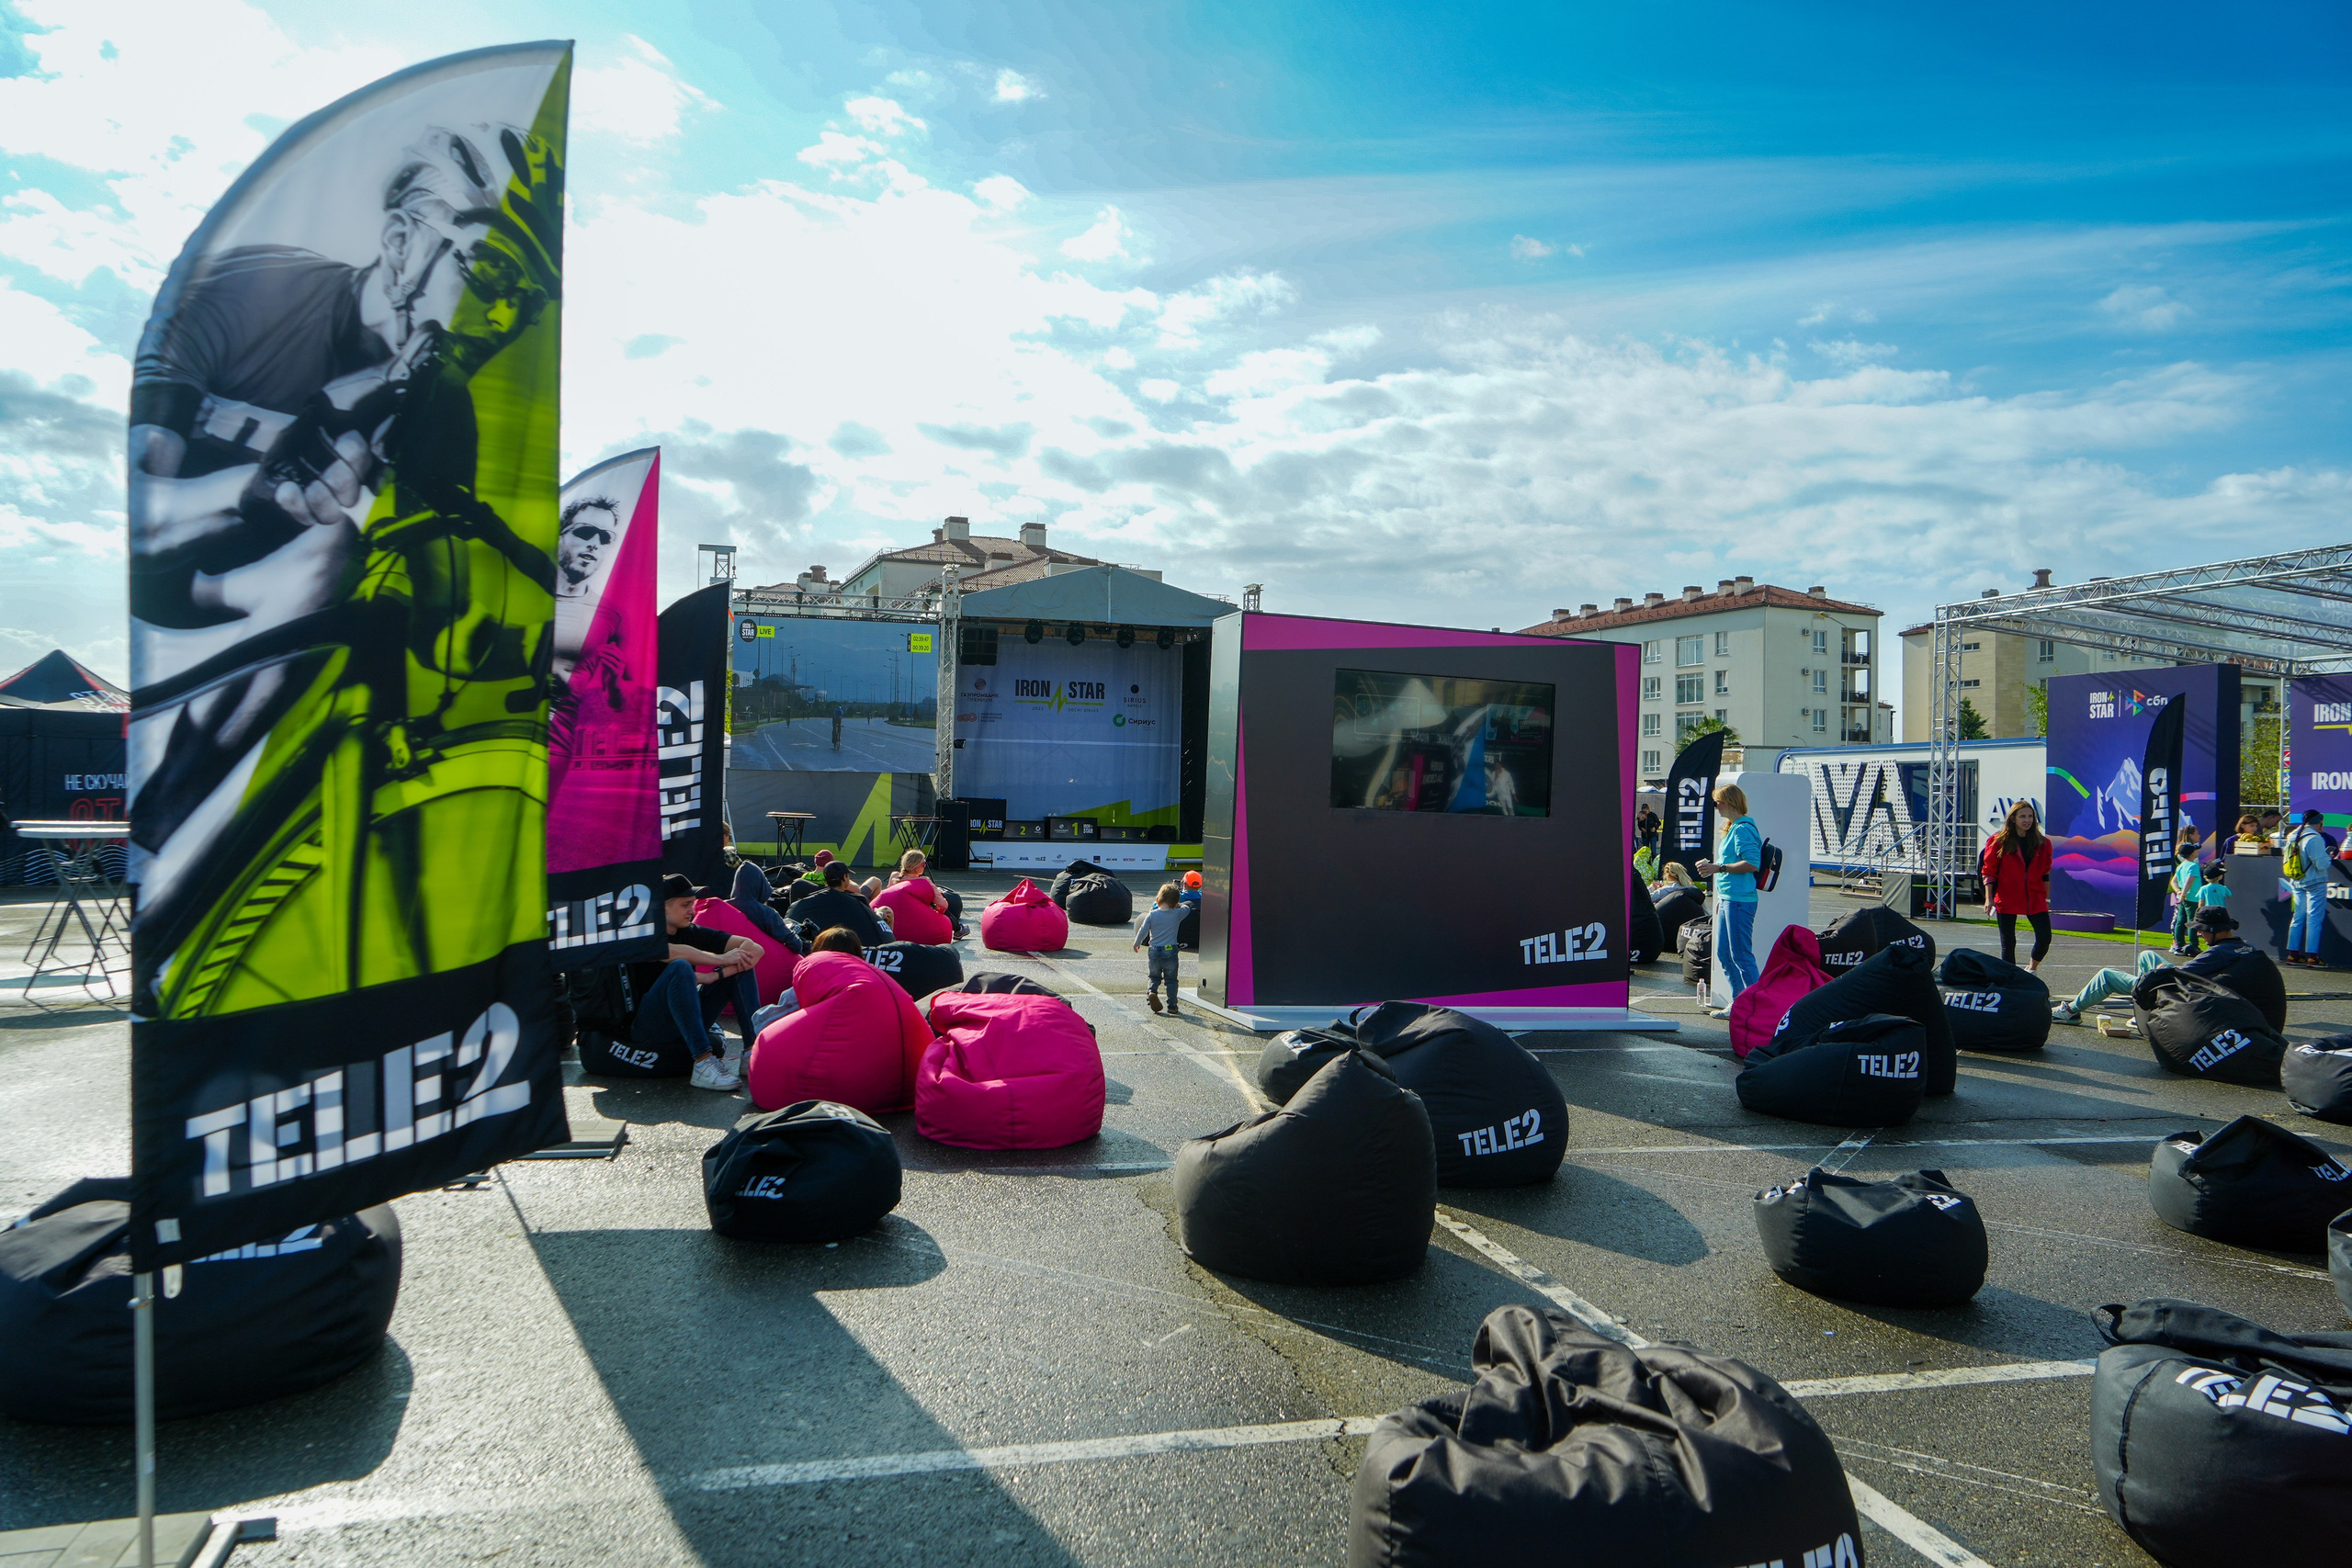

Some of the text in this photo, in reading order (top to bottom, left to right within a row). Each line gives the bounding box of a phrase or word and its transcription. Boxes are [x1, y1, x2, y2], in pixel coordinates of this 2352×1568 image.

[1015, 679, 1105, 700] IRON STAR
[2089, 692, 2108, 704] IRON
[2089, 704, 2114, 718] STAR
[2146, 695, 2168, 706] сбп
[1128, 717, 1156, 726] Сириус
[2313, 703, 2351, 722] IRON
[657, 680, 704, 841] TELE2
[65, 774, 83, 790] НЕ
[2312, 772, 2352, 790] IRON
[1678, 776, 1708, 851] TELE2
[2145, 767, 2172, 880] TELE2
[988, 820, 1003, 829] STAR
[1020, 826, 1026, 836] 2
[1071, 822, 1079, 836] 1
[547, 884, 654, 951] LE2
[1520, 922, 1608, 965] TELE2
[862, 950, 904, 973] LE2
[1825, 950, 1864, 965] TELE2
[1944, 992, 2001, 1013] TELE2
[608, 1040, 659, 1069] TELE2
[2188, 1029, 2251, 1072] TELE2
[1857, 1051, 1920, 1079] TELE2
[186, 1002, 530, 1198] TELE2
[1458, 1108, 1544, 1156] TELE2
[735, 1175, 786, 1199] LE2
